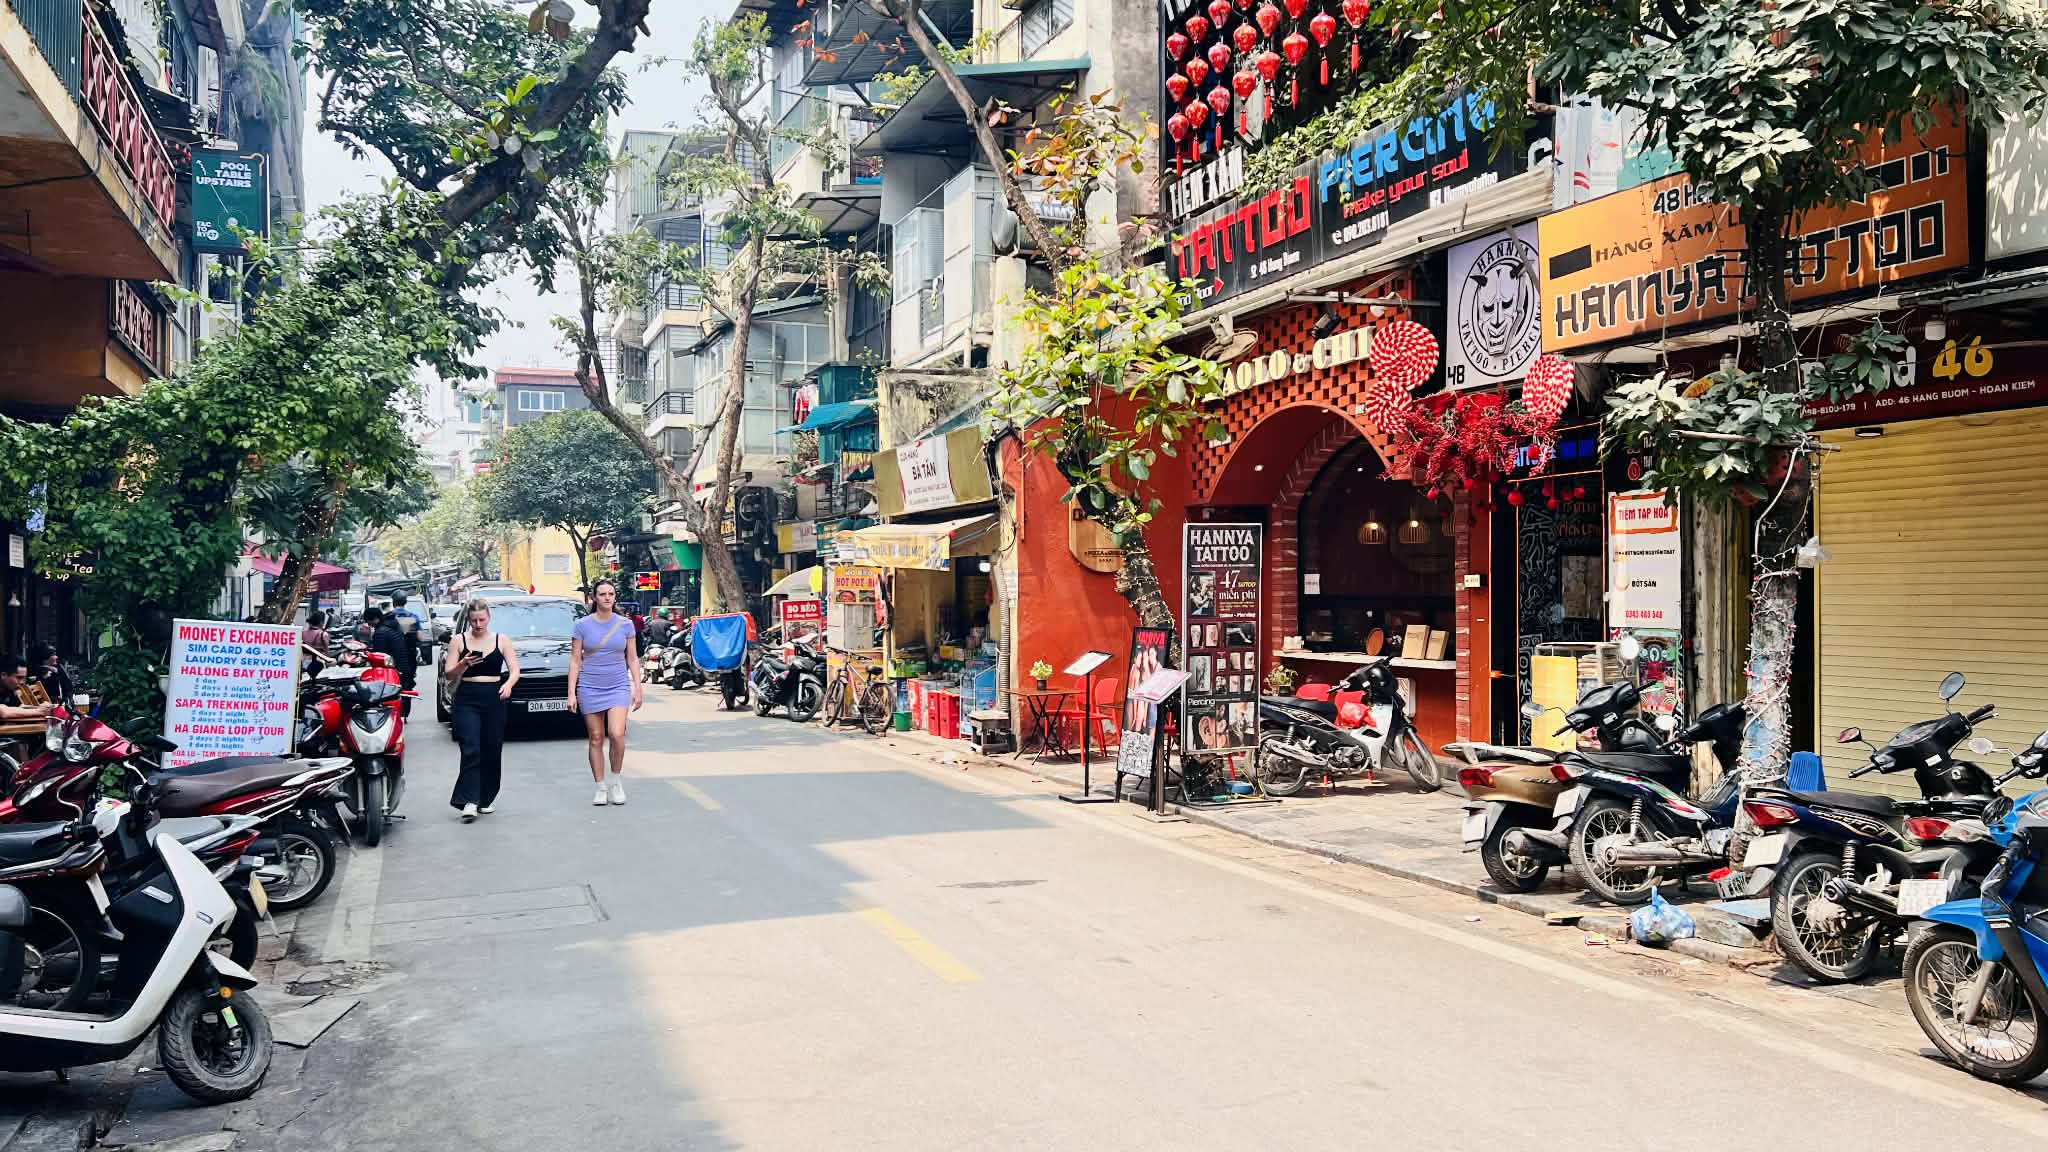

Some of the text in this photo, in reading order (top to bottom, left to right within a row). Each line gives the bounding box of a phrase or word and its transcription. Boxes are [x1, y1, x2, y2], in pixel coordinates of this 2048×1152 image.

[215, 170, 252, 179] TABLE
[220, 162, 252, 171] POOL
[196, 176, 252, 188] UPSTAIRS
[1344, 188, 1385, 218] make
[1388, 171, 1428, 203] your
[1431, 148, 1469, 182] soul
[1653, 186, 1681, 216] 48
[1172, 176, 1311, 278] TATTOO
[1595, 220, 1712, 263] HÀNG XĂM
[1932, 336, 1994, 380] 46
[1218, 348, 1291, 397] AOLO
[1447, 365, 1465, 385] 48
[1875, 398, 1897, 408] ADD:
[1898, 396, 1910, 404] 46
[1912, 391, 1939, 403] HANG
[1941, 387, 1970, 399] BUOM
[1979, 383, 2009, 395] HOAN
[2011, 380, 2036, 392] KIEM
[1190, 529, 1255, 545] HANNYA
[1194, 545, 1250, 562] TATTOO
[44, 570, 70, 581] Sup
[72, 563, 94, 575] Tea
[1220, 569, 1240, 588] 47
[179, 626, 296, 646] MONEY EXCHANGE
[188, 643, 208, 653] SIM
[210, 645, 242, 655] CARD
[245, 647, 261, 656] 4G
[271, 647, 286, 656] 5G
[186, 654, 286, 667] LAUNDRY SERVICE
[180, 666, 289, 679] HALONG BAY TOUR
[175, 698, 289, 711] SAPA TREKKING TOUR
[174, 724, 285, 736] HA GIANG LOOP TOUR
